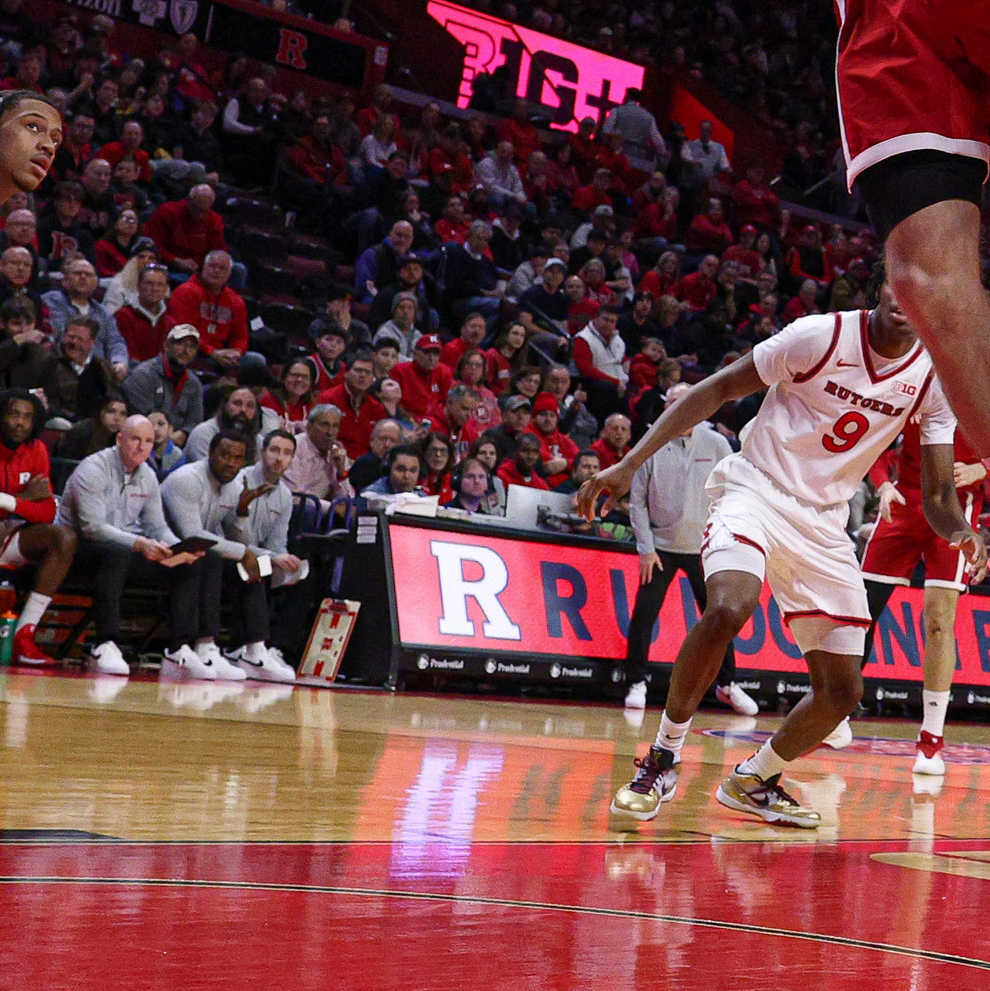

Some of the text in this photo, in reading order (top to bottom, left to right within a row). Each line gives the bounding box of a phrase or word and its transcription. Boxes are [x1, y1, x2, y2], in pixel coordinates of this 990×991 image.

[276, 28, 308, 69] R
[823, 380, 906, 417] RUTGERS
[822, 410, 870, 453] 9
[429, 540, 522, 641] R
[540, 560, 593, 641] R
[430, 658, 464, 670] Prudential
[498, 662, 530, 675] Prudential
[562, 666, 593, 678] Prudential
